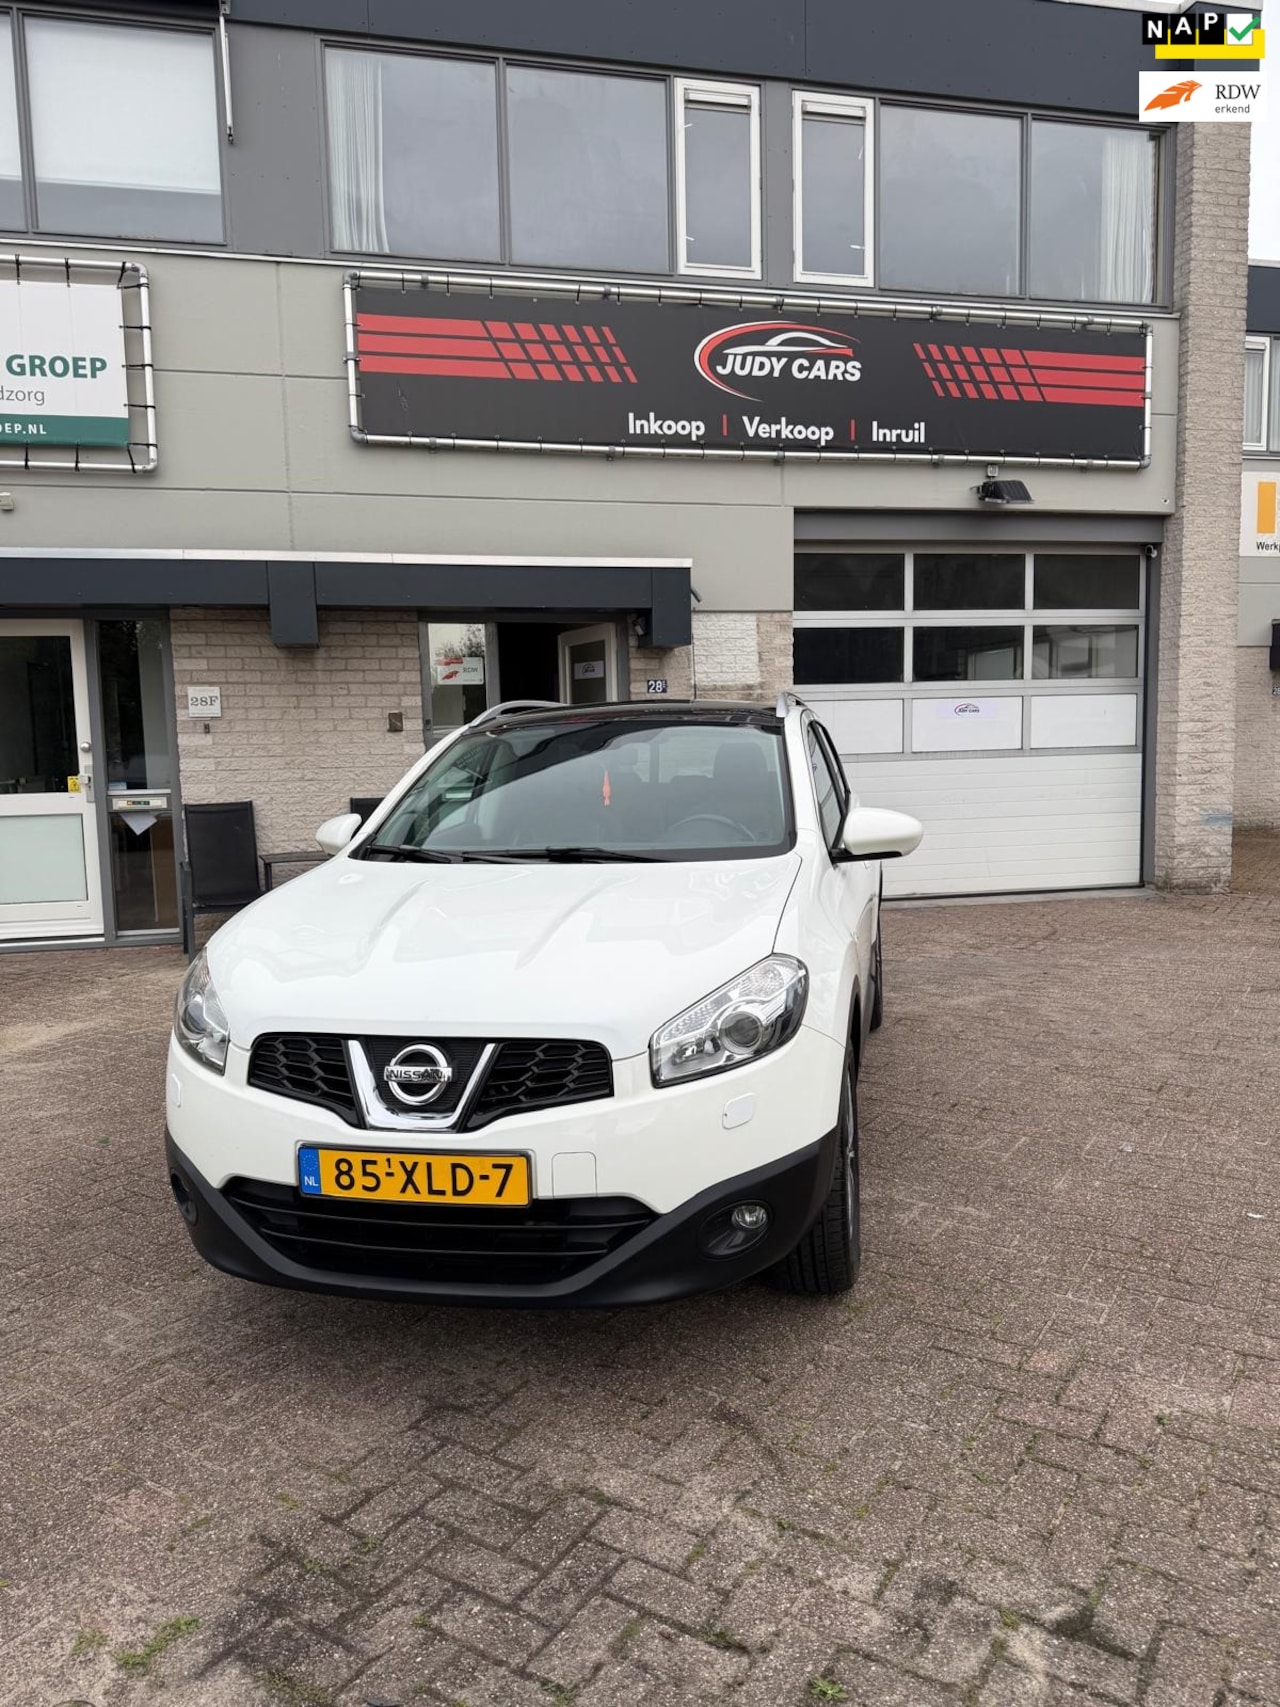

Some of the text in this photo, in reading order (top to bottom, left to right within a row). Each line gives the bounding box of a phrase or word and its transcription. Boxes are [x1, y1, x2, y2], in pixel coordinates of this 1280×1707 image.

[5, 353, 108, 379] GROEP
[716, 354, 862, 382] JUDY CARS
[0, 422, 47, 434] EP.NL
[628, 412, 926, 446] Inkoop Verkoop Inruil
[1256, 541, 1280, 552] Werk
[648, 680, 663, 693] 28
[190, 695, 219, 706] 28F
[388, 1068, 444, 1081] NISSAN
[304, 1176, 319, 1187] NL
